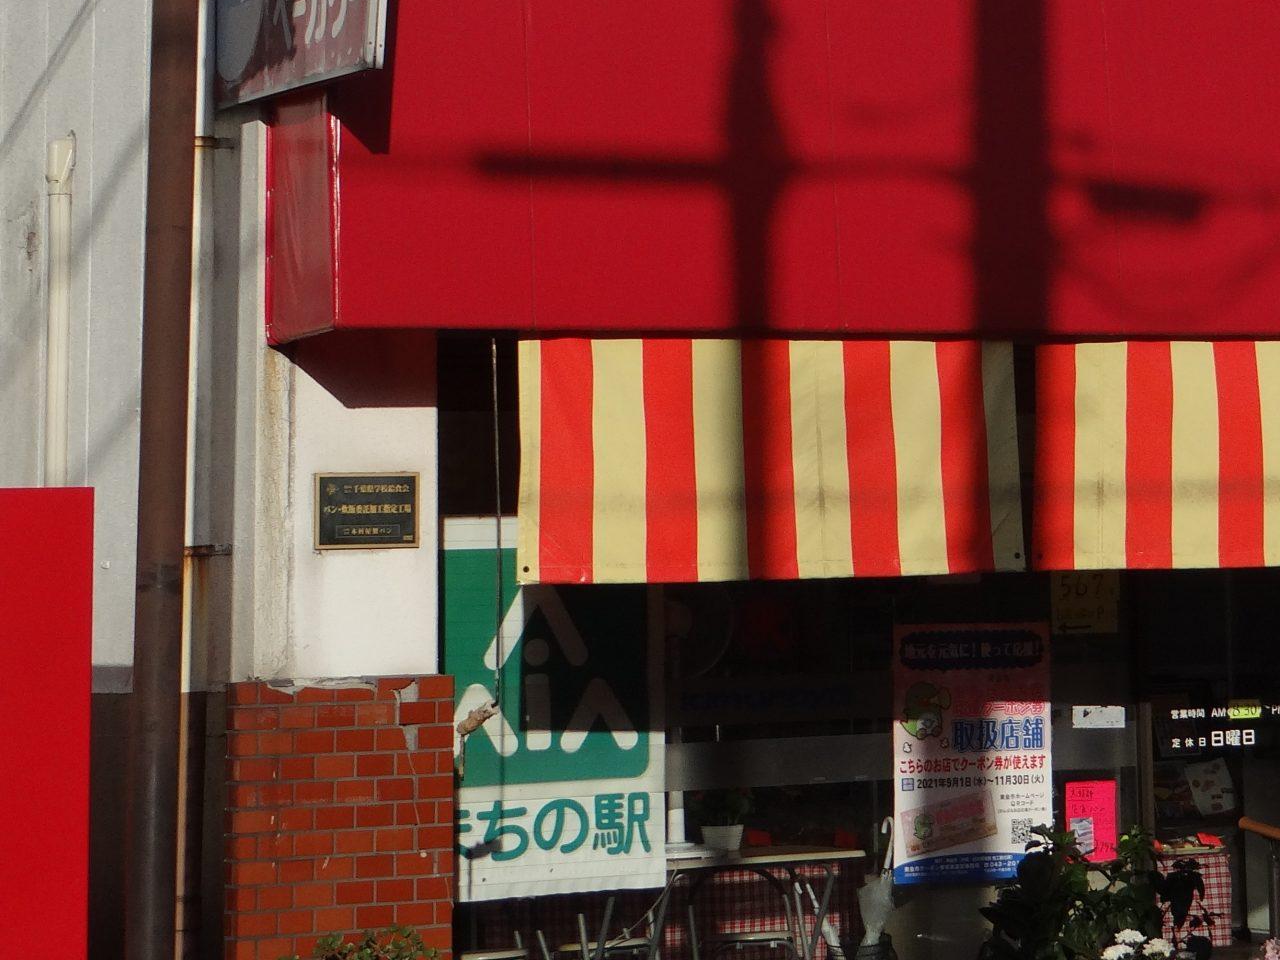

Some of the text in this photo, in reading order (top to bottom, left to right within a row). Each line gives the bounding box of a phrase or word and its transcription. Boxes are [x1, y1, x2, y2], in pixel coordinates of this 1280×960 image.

[1171, 708, 1205, 719] 営業時間
[1211, 708, 1226, 717] AM
[953, 718, 1045, 752] 取扱店舗
[1171, 729, 1255, 748] 定休日 日曜日
[900, 755, 1046, 775] こちらのお店でクーポン券が使えます
